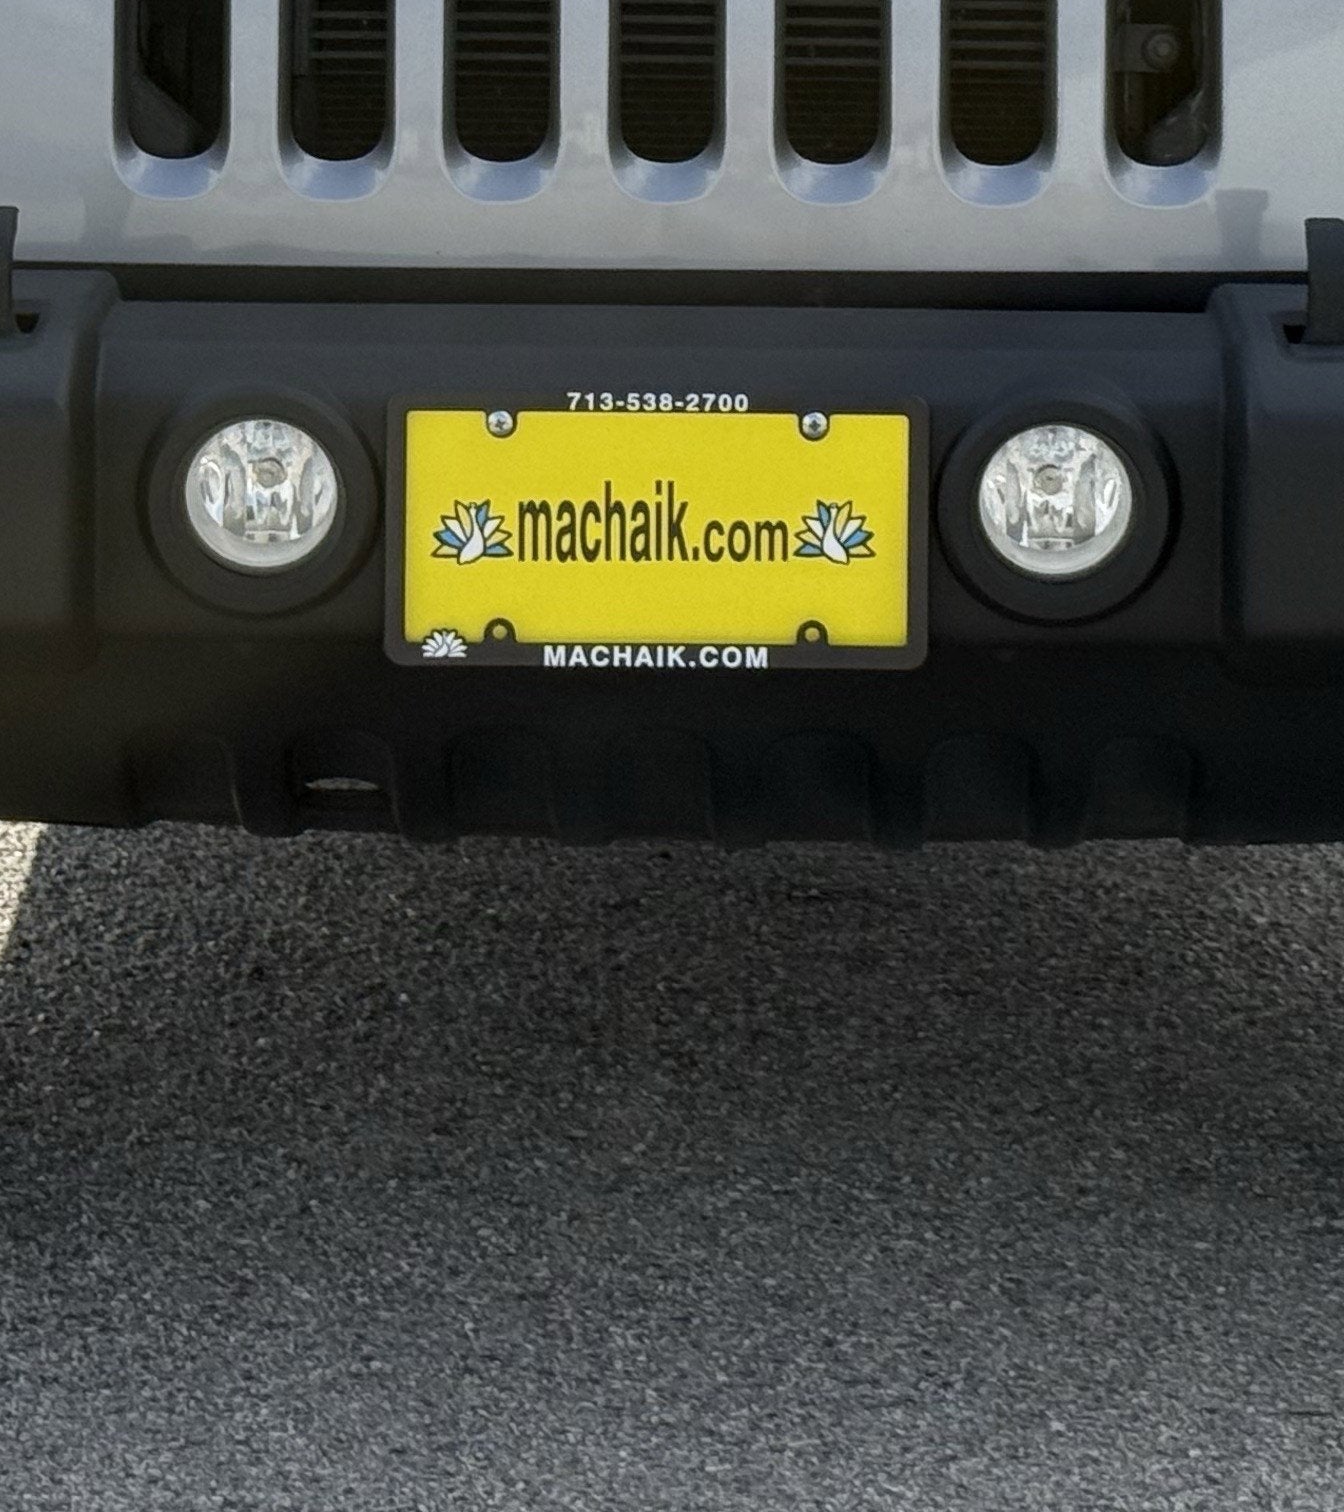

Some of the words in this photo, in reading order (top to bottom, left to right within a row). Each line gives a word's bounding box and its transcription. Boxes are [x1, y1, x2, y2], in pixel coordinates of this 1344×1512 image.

[566, 392, 749, 412] 713-538-2700
[517, 481, 789, 563] machaik.com
[543, 646, 769, 669] MACHAIK.COM
